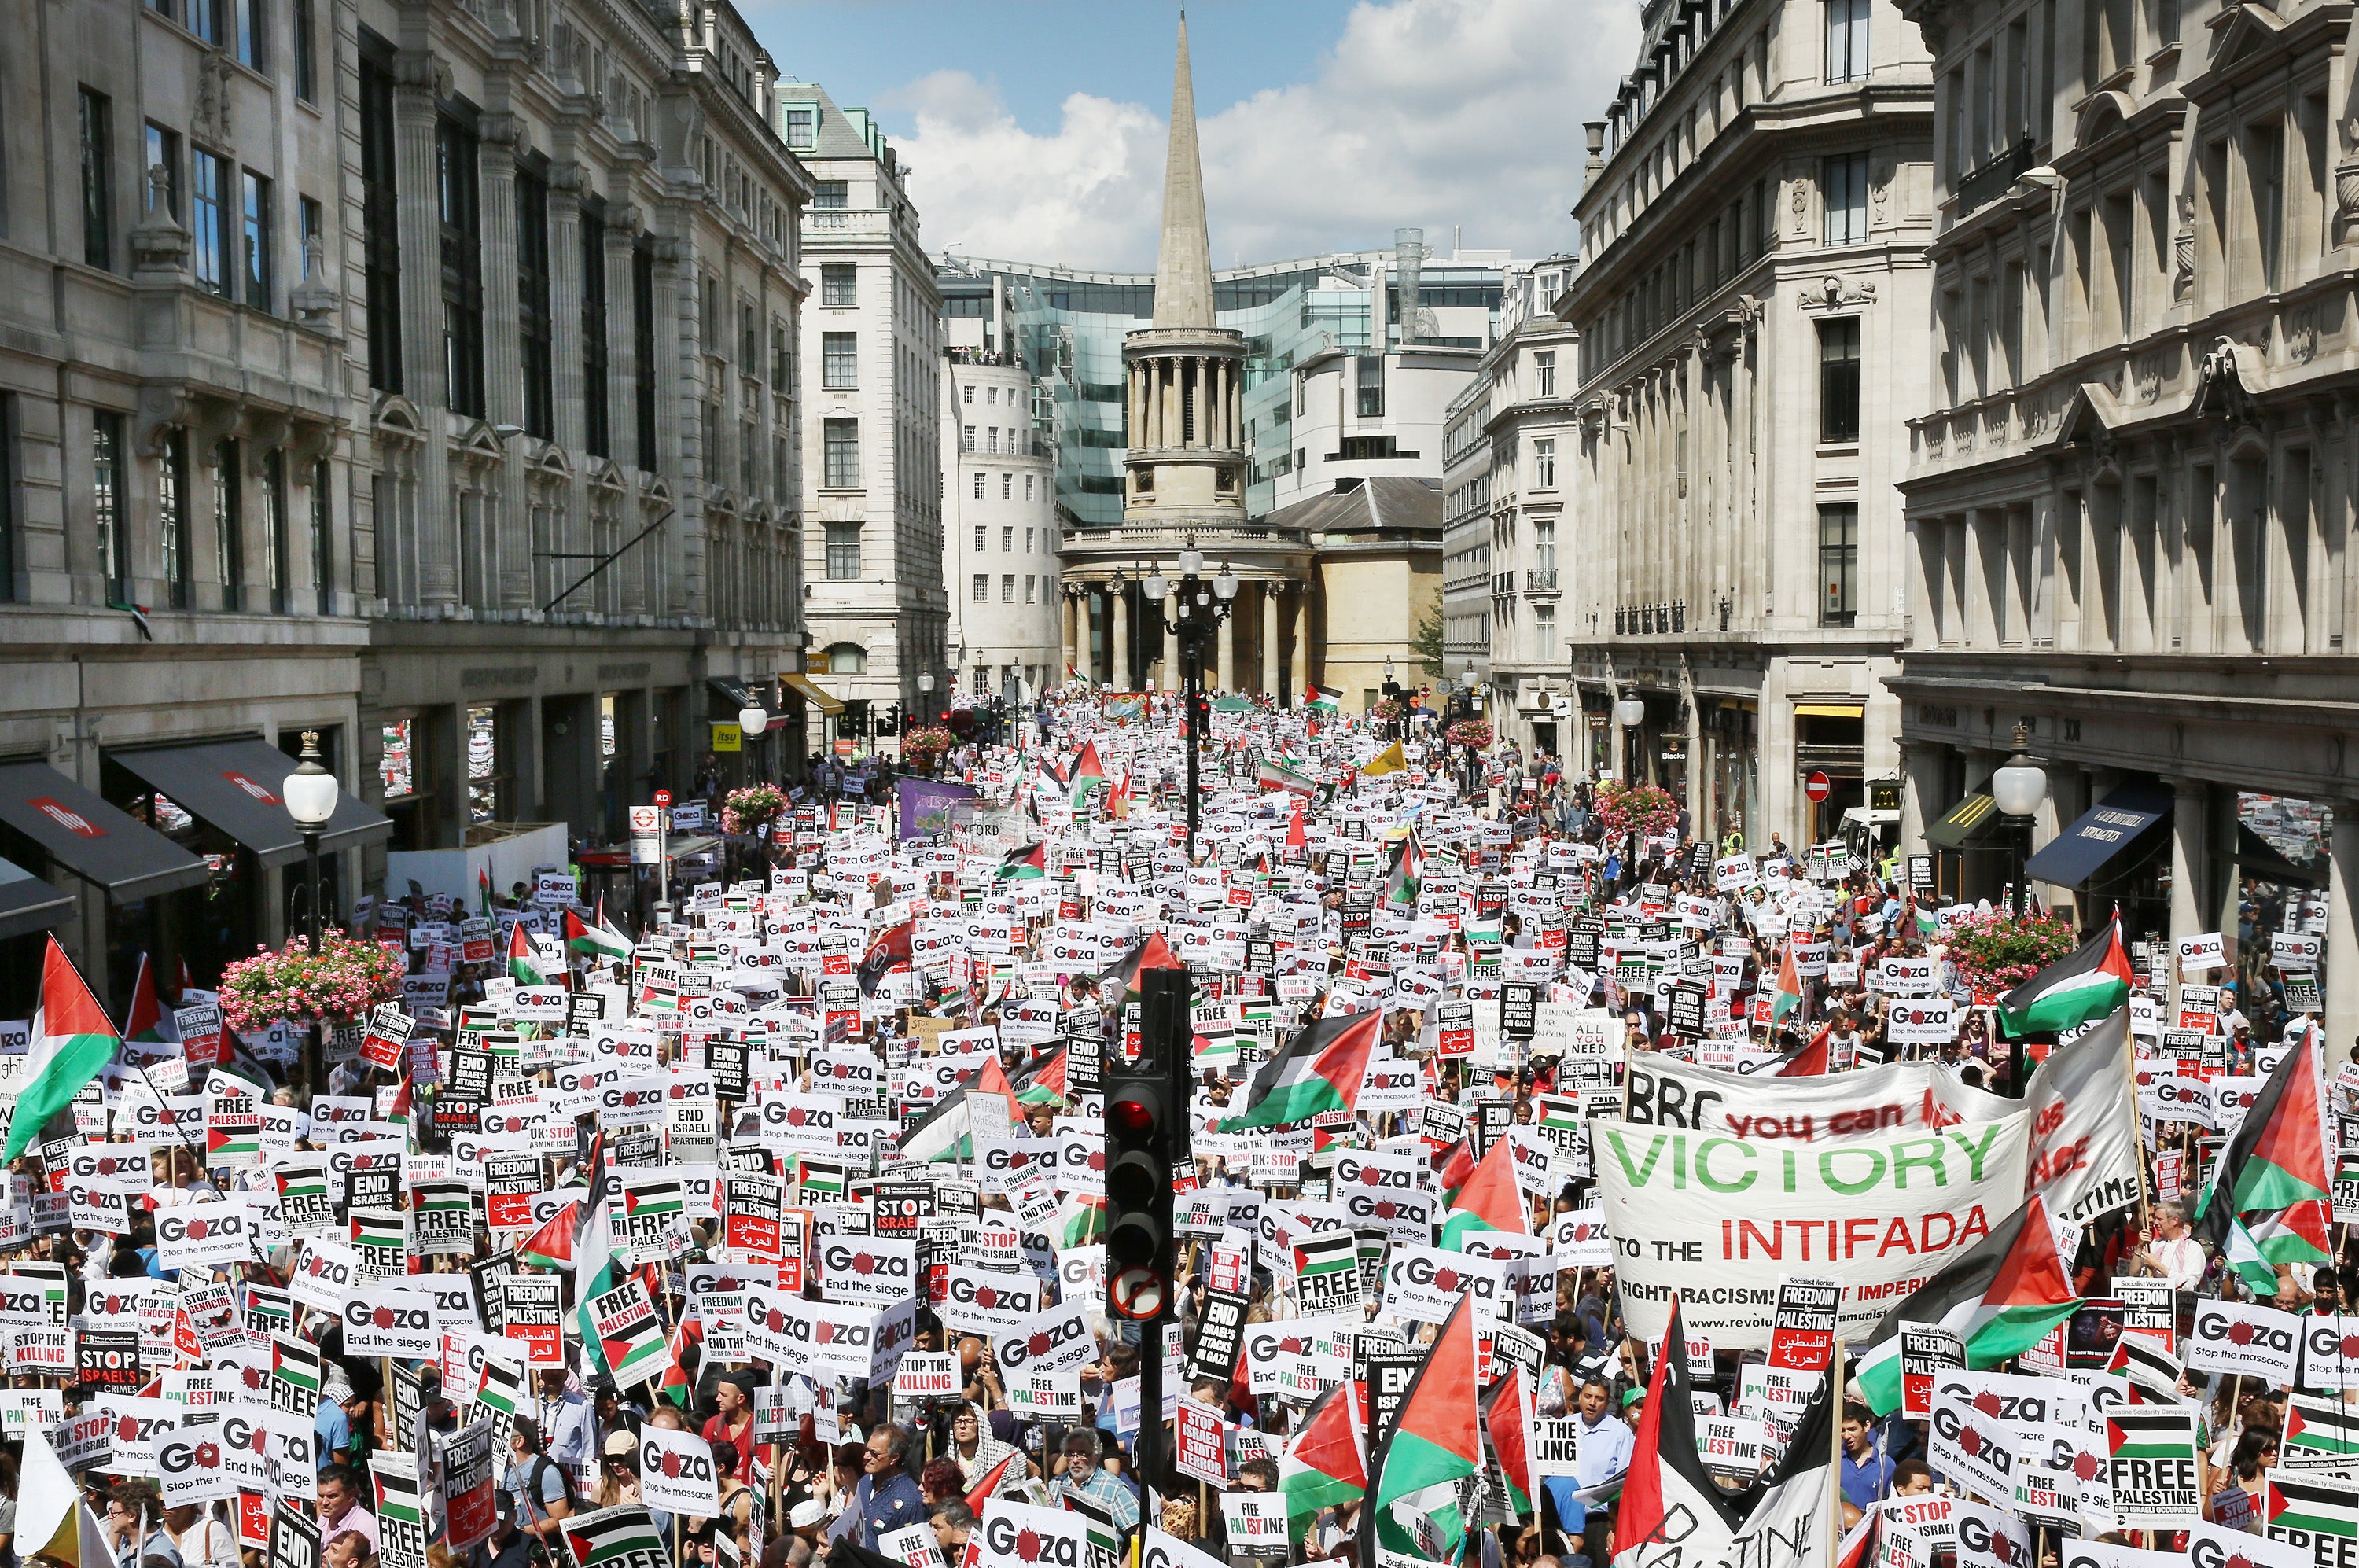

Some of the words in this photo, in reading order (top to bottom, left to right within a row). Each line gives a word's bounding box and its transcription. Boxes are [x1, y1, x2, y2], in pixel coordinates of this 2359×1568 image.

[718, 731, 737, 741] itsu
[952, 825, 999, 837] OXFORD
[1698, 844, 1709, 853] END
[1827, 856, 1847, 868] FREE
[1886, 963, 1930, 980] Gza
[1507, 988, 1530, 1001] END
[2285, 986, 2316, 997] FREE
[1441, 1006, 1470, 1016] FREEDOM
[1505, 1002, 1531, 1010] ISRAEL'S
[1003, 1006, 1052, 1023] Gza
[1196, 1008, 1229, 1021] FREE
[1193, 1019, 1232, 1030] PALESTINE
[1439, 1021, 1472, 1030] PALESTINE
[1577, 1025, 1603, 1034] ALL
[1572, 1044, 1606, 1054] NEED
[2158, 1084, 2210, 1110] Gza
[215, 1098, 254, 1114] FREE
[2187, 1106, 2210, 1118] massacre
[136, 1105, 203, 1126] Gza
[209, 1113, 259, 1125] PALESTINE
[678, 1109, 704, 1122] END
[1727, 1111, 1812, 1142] you
[1830, 1103, 1903, 1135] can
[137, 1128, 156, 1139] End
[160, 1128, 175, 1137] the
[673, 1123, 711, 1133] ISRAELI
[530, 1140, 555, 1149] ARMING
[557, 1139, 577, 1148] ISRAEL
[671, 1136, 714, 1147] APARTHEID
[764, 1131, 781, 1141] Stop
[798, 1133, 833, 1143] massacre
[1276, 1168, 1297, 1176] ISRAEL
[2163, 1160, 2177, 1169] STOP
[2160, 1169, 2178, 1179] ISRAELI
[733, 1181, 777, 1200] FREEDOM
[2162, 1180, 2177, 1188] STATE
[2159, 1188, 2178, 1198] TERROR
[281, 1195, 329, 1216] FREE
[730, 1202, 778, 1218] PALESTINE
[283, 1209, 333, 1223] PALESTINE
[1614, 1238, 1641, 1257] TO
[1650, 1239, 1701, 1261] THE
[1722, 1205, 1989, 1261] INTIFADA
[826, 1250, 907, 1277] Gza
[826, 1279, 847, 1290] End
[851, 1280, 874, 1291] the
[876, 1283, 909, 1297] siege
[1297, 1272, 1358, 1300] FREE
[1622, 1279, 1671, 1303] FIGHT
[1680, 1289, 1775, 1304] RACISM!
[184, 1289, 207, 1305] STOP
[208, 1286, 228, 1297] THE
[507, 1288, 554, 1302] FREEDOM
[596, 1282, 640, 1319] FREE
[702, 1297, 743, 1306] FREEDOM
[1301, 1293, 1360, 1311] PALESTINE
[1783, 1287, 1835, 1305] FREEDOM
[188, 1297, 232, 1311] GENOCIDE
[346, 1300, 429, 1328] Gza
[507, 1310, 559, 1324] PALESTINE
[599, 1303, 652, 1334] PALESTINE
[1207, 1301, 1238, 1326] END
[1777, 1312, 1835, 1330] PALESTINE
[1202, 1323, 1238, 1339] ISRAEL'S
[2199, 1312, 2292, 1353] Gza
[14, 1336, 40, 1348] STOP
[42, 1335, 65, 1346] THE
[203, 1335, 246, 1352] CHILDREN
[348, 1334, 369, 1345] End
[371, 1336, 394, 1346] the
[396, 1337, 431, 1351] siege
[710, 1339, 727, 1348] END
[1199, 1337, 1232, 1353] ATTACKS
[16, 1347, 65, 1362] KILLING
[80, 1350, 136, 1368] STOP
[1196, 1351, 1207, 1362] ON
[1209, 1353, 1230, 1366] GAZA
[1783, 1349, 1822, 1367] الحرية
[2196, 1347, 2217, 1360] Stop
[2222, 1349, 2236, 1359] the
[2239, 1353, 2289, 1370] massacre
[79, 1368, 136, 1383] ISRAEL'S
[1767, 1375, 1792, 1387] FREE
[103, 1383, 137, 1394] CRIMES
[187, 1378, 212, 1390] FREE
[1031, 1379, 1053, 1390] FREE
[166, 1390, 234, 1405] PALESTINE
[1014, 1390, 1076, 1405] PALESTINE
[1187, 1412, 1216, 1427] STOP
[1183, 1423, 1220, 1445] ISRAELI
[1186, 1439, 1216, 1460] STATE
[644, 1442, 711, 1482] Gza
[1181, 1451, 1222, 1476] TERROR
[2112, 1461, 2195, 1489] FREE
[645, 1481, 658, 1493] Stop
[660, 1485, 671, 1495] the
[673, 1488, 713, 1500] massacre
[2113, 1490, 2197, 1505] PALESTINE
[2114, 1505, 2130, 1514] END
[2131, 1505, 2156, 1514] ISRAELI
[2158, 1506, 2198, 1515] OCCUPATION
